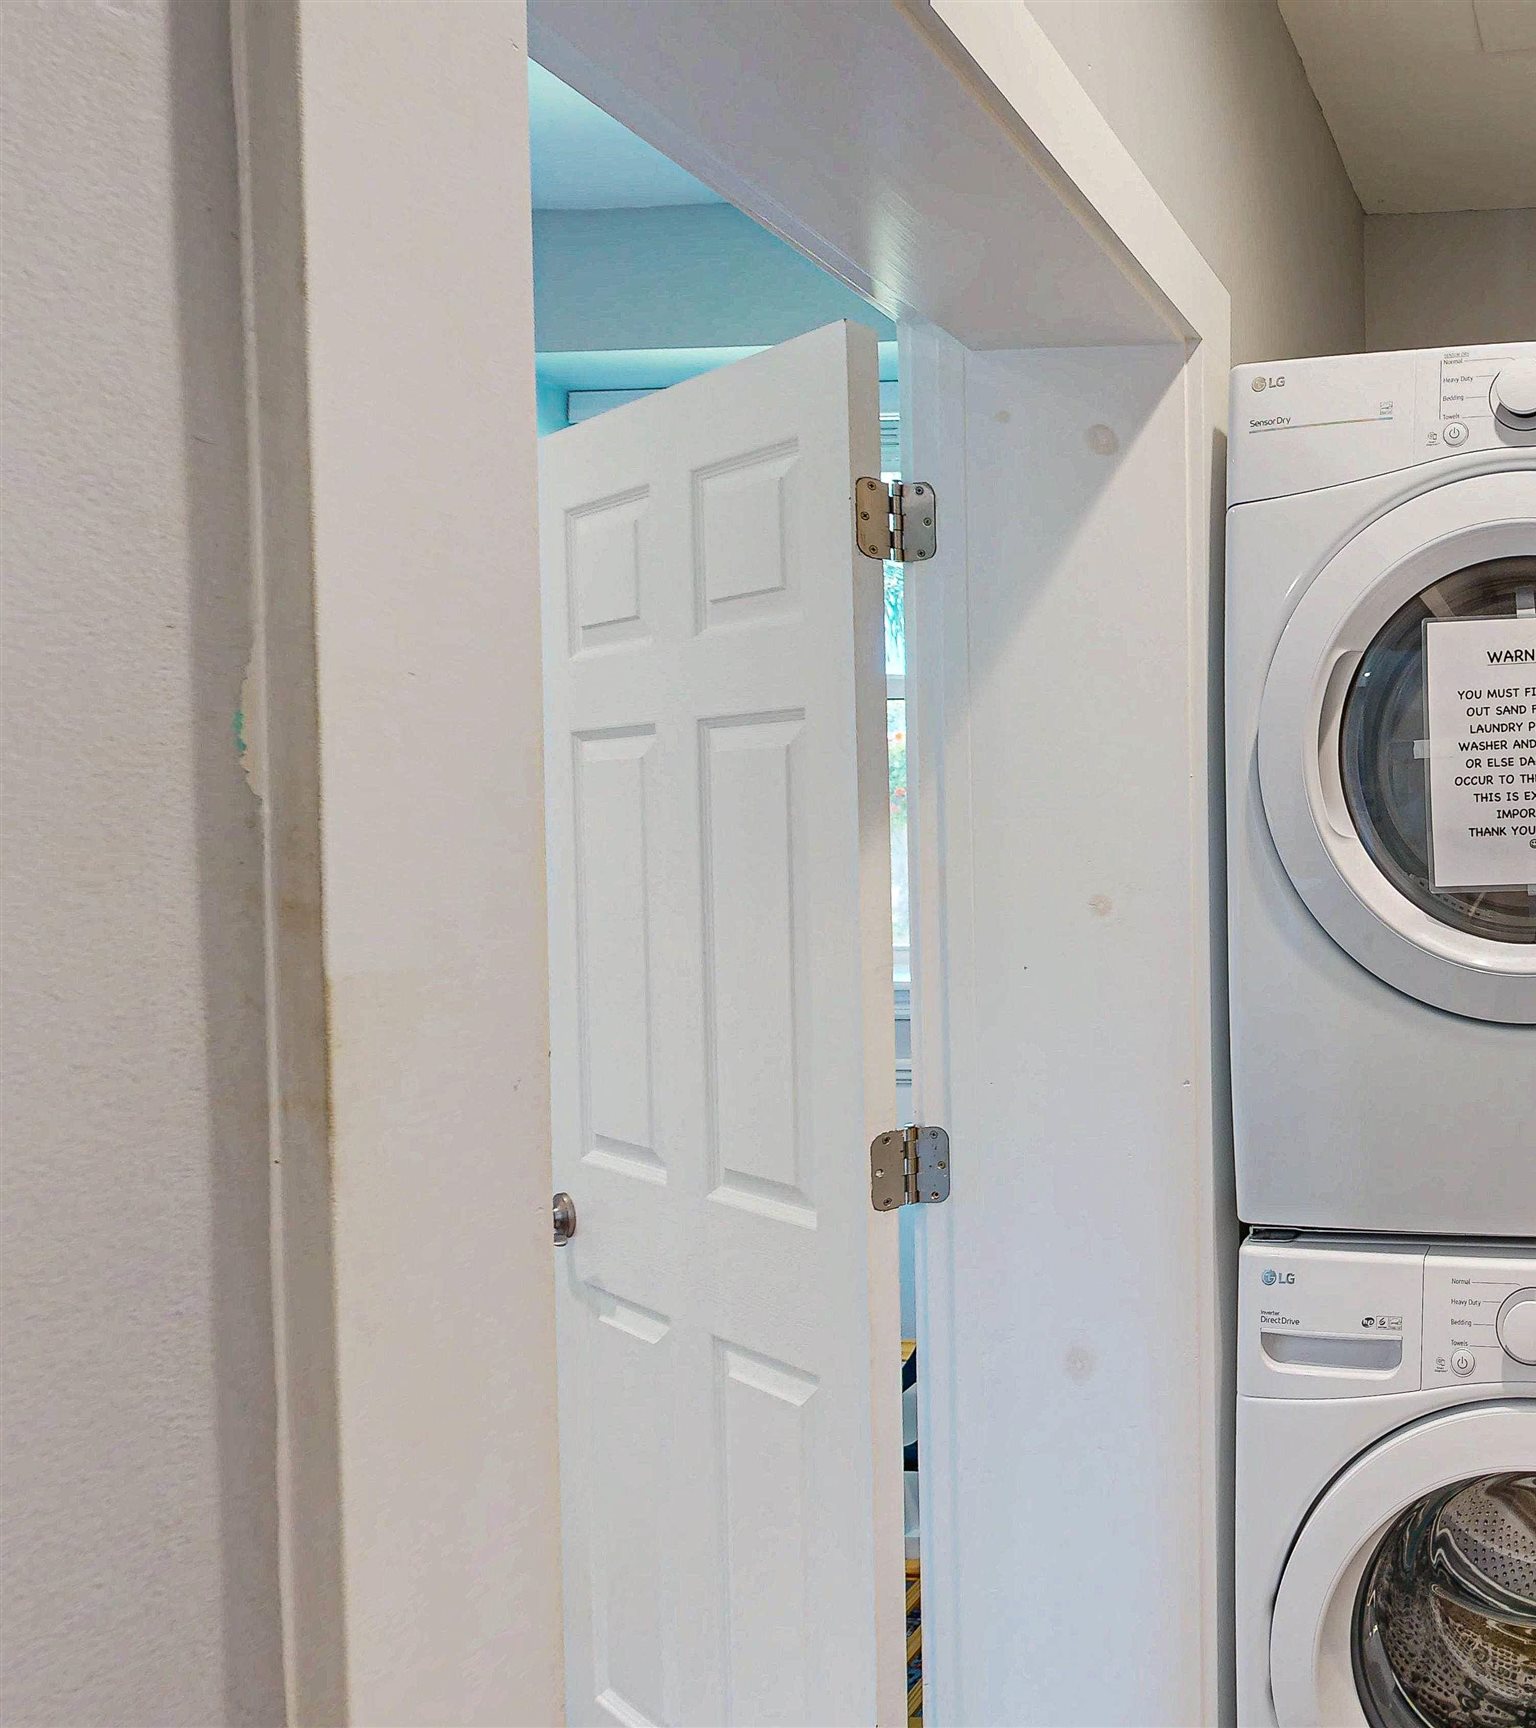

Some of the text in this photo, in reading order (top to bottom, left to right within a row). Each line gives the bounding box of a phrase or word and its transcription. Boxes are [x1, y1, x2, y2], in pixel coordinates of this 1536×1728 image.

[1268, 376, 1286, 389] LG
[1443, 394, 1464, 402] Bedding
[1458, 690, 1482, 700] YOU
[1487, 688, 1519, 698] MUST
[1467, 707, 1490, 716] OUT
[1496, 705, 1526, 715] SAND
[1470, 722, 1523, 734] LAUNDRY
[1458, 740, 1507, 751] WASHER
[1466, 758, 1482, 768] OR
[1487, 757, 1514, 767] ELSE
[1455, 775, 1493, 786] OCCUR
[1499, 775, 1514, 784] TO
[1473, 793, 1501, 802] THIS
[1507, 792, 1519, 801] IS
[1469, 827, 1507, 837] THANK
[1511, 826, 1536, 835] YOU
[1278, 1272, 1295, 1284] LG
[1450, 1319, 1472, 1327] Bedding
[1450, 1339, 1468, 1347] Towels
